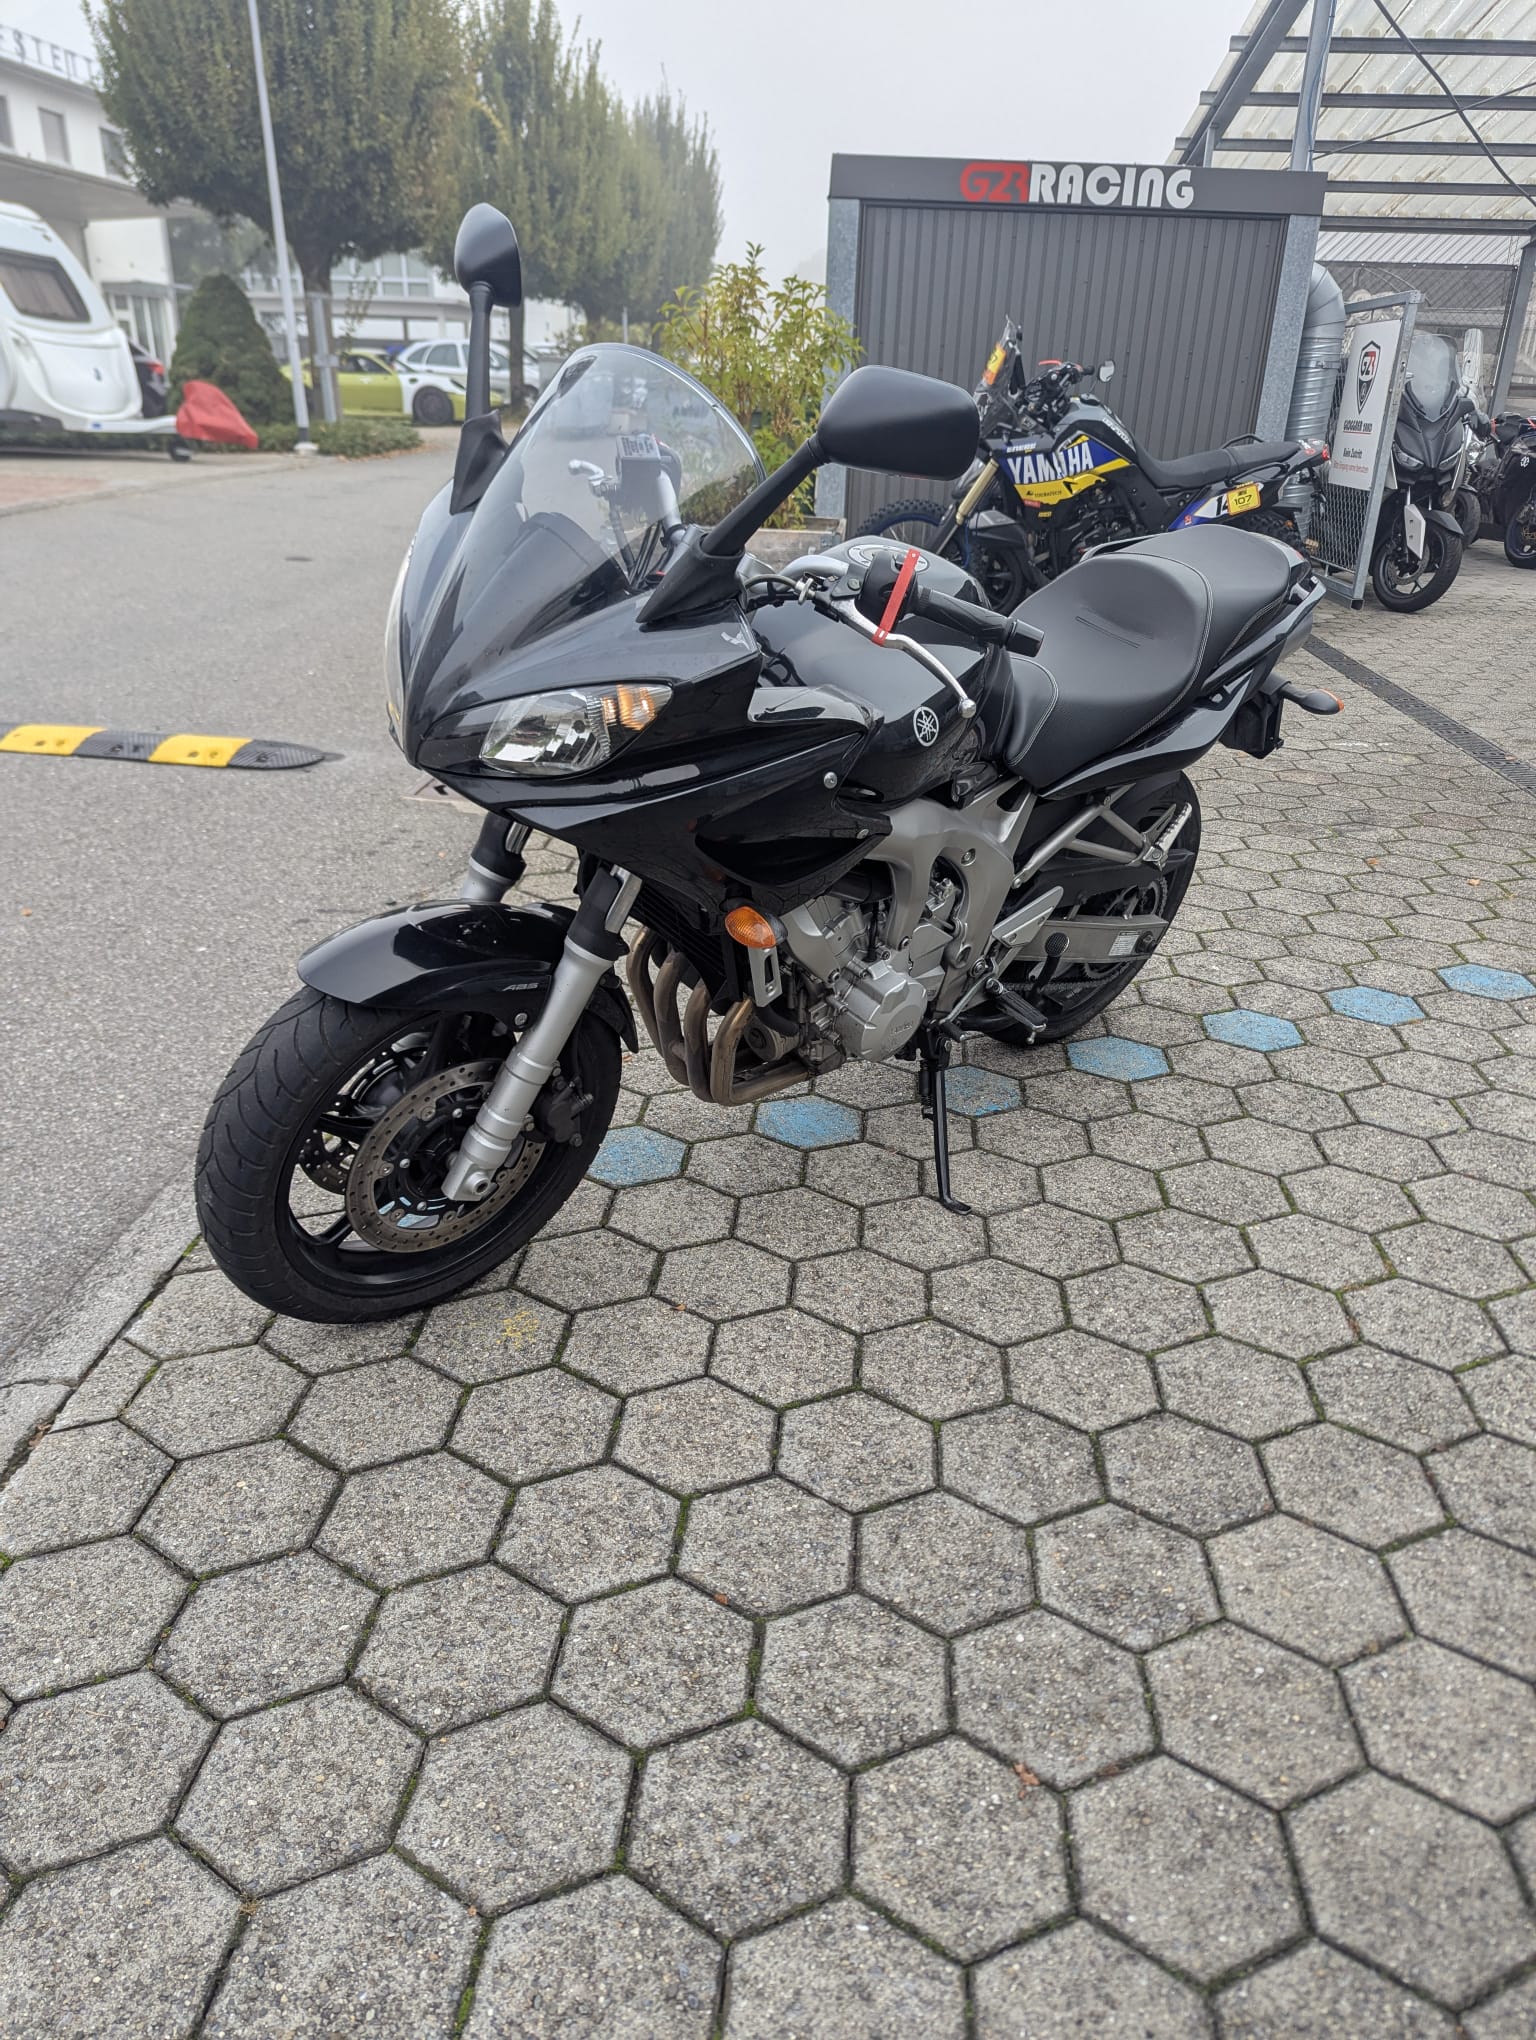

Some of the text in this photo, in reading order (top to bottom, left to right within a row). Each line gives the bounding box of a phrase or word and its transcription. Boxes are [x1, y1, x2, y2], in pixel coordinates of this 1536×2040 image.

[1029, 163, 1194, 209] RACING
[1006, 441, 1094, 485] YAMAHA
[1233, 494, 1253, 506] 107
